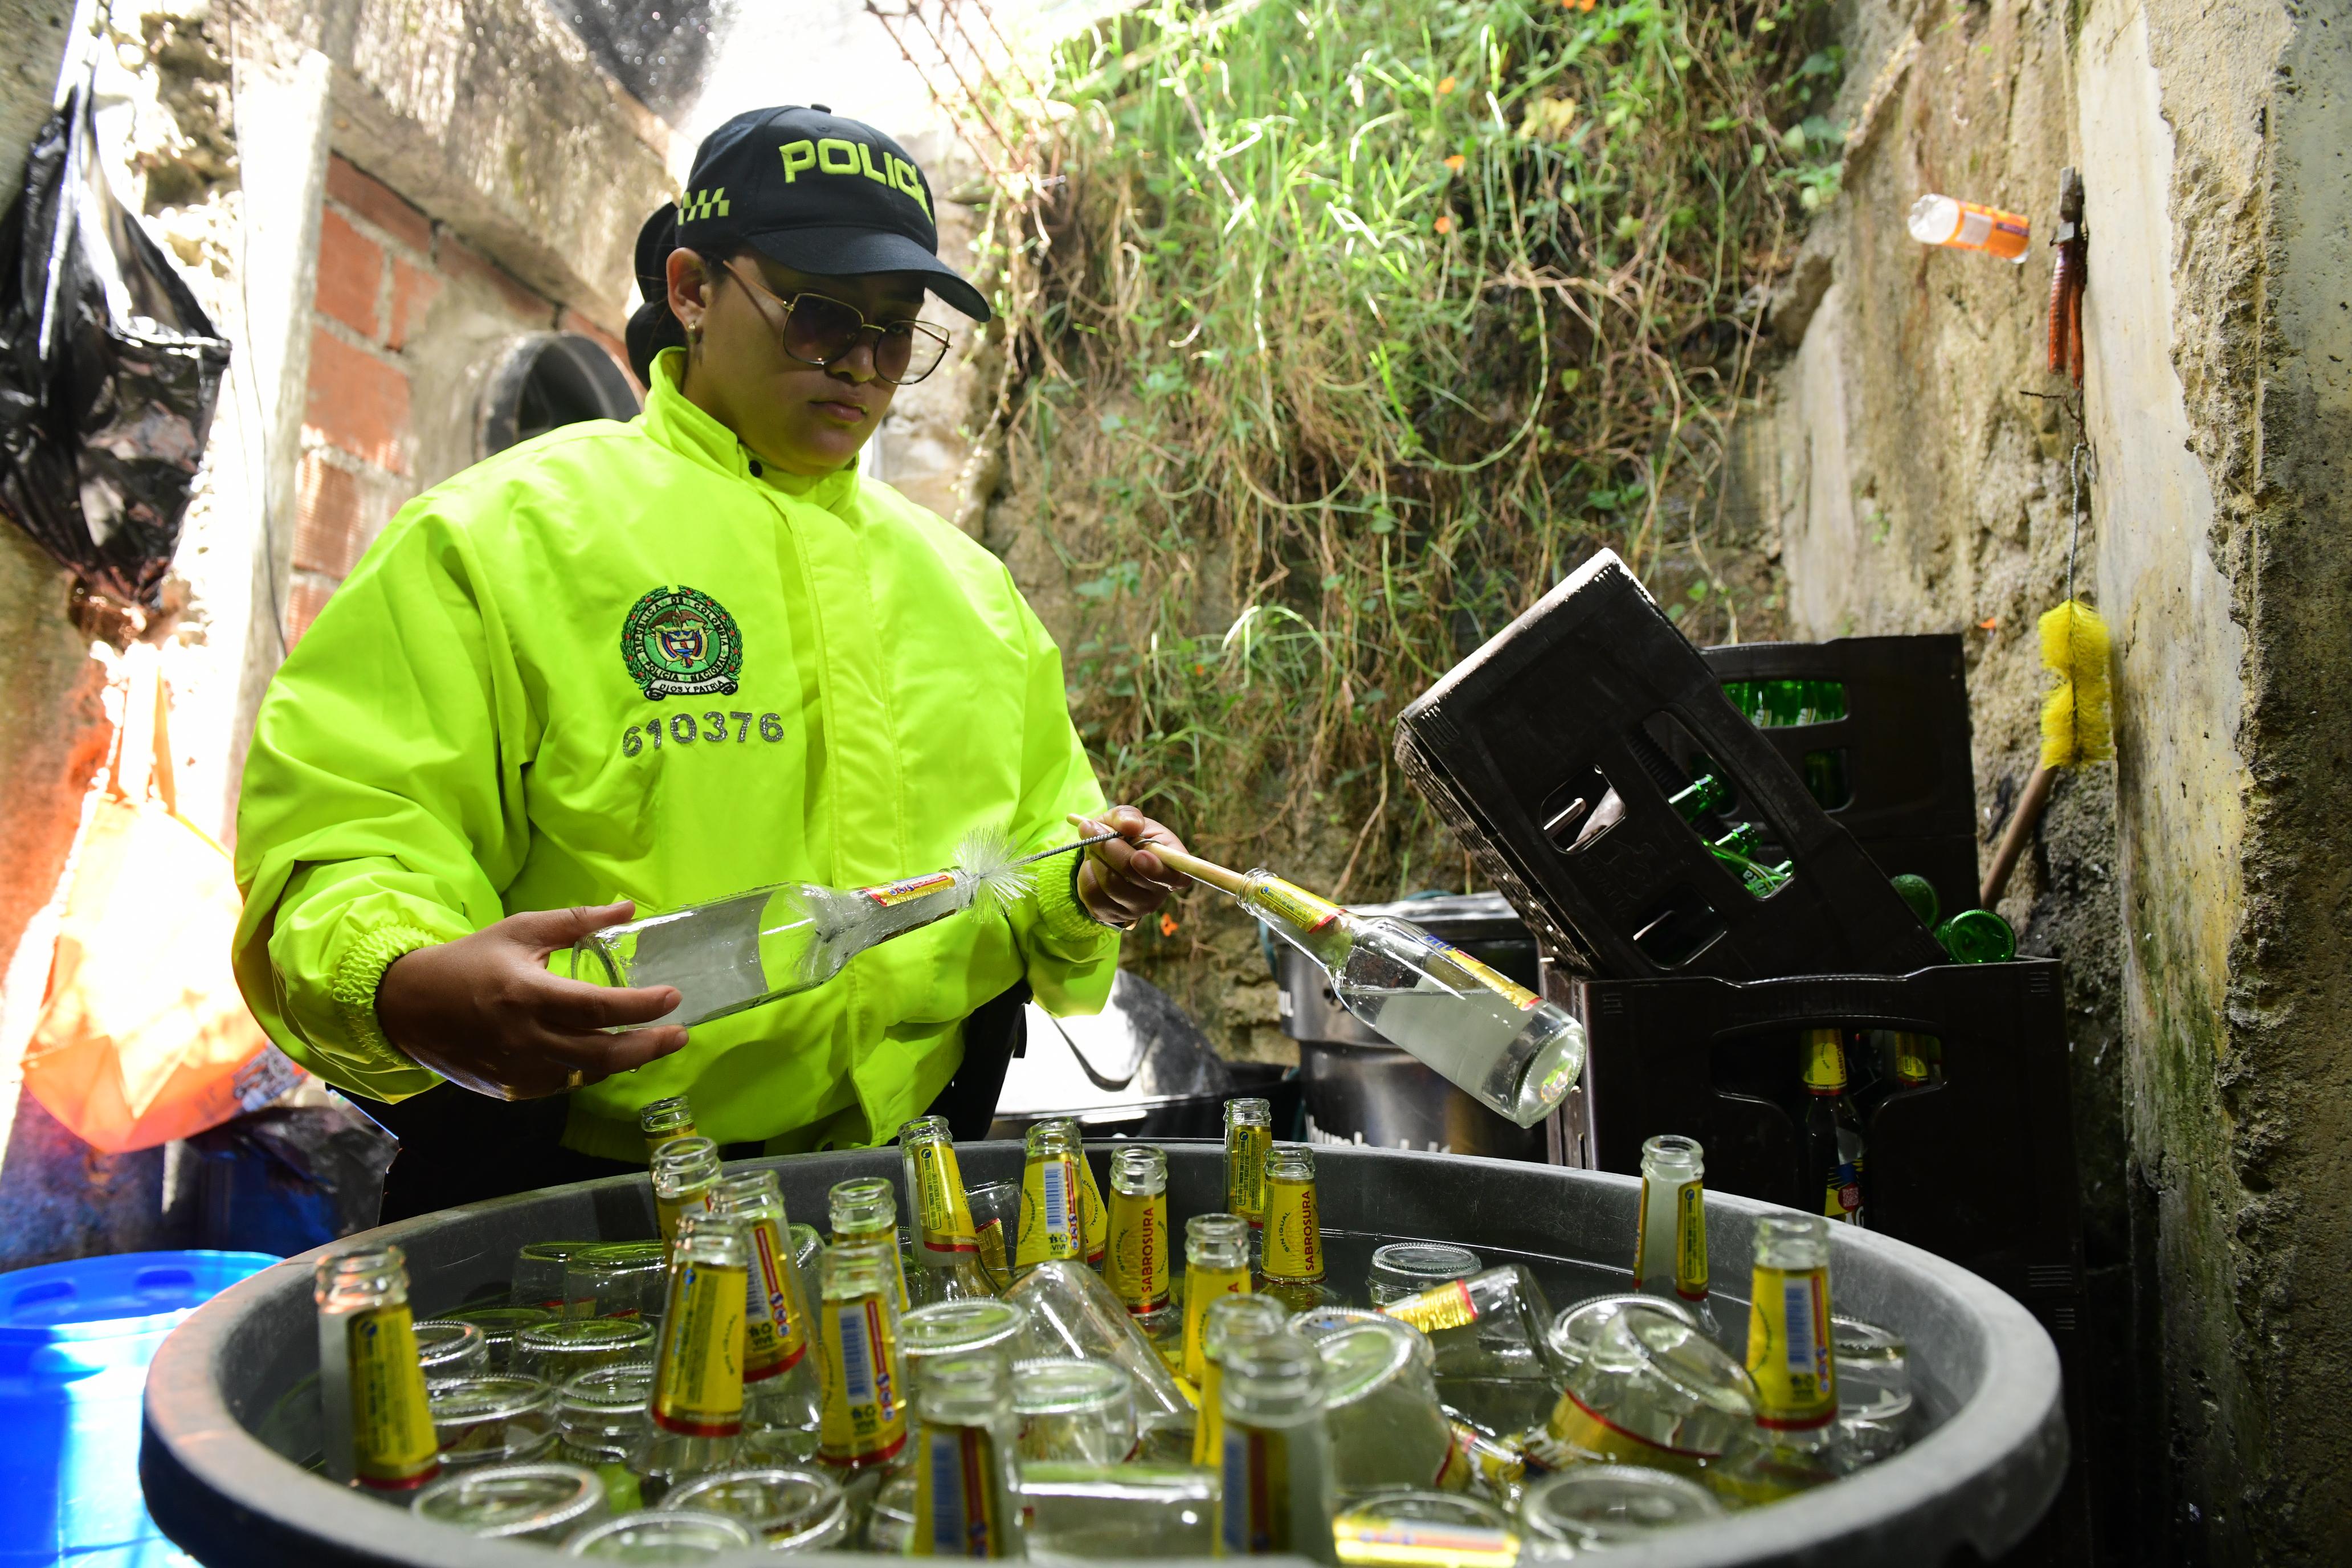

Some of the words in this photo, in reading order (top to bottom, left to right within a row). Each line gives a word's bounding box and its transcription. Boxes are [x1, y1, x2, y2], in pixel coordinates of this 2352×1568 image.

[779, 138, 934, 226] POLIC
[695, 602, 729, 647] COLOMBIA
[691, 655, 727, 682] NACIONAL
[659, 684, 683, 693] DIOS
[693, 680, 725, 693] PATRIA
[623, 712, 784, 757] 610376
[1279, 1211, 1291, 1237] IGUAL
[1301, 1190, 1314, 1272] SABROSURA
[1116, 1228, 1129, 1253] IGUAL
[1141, 1207, 1154, 1293] SABROSURA
[1280, 1238, 1290, 1253] SIN
[1117, 1255, 1125, 1272] SIN
